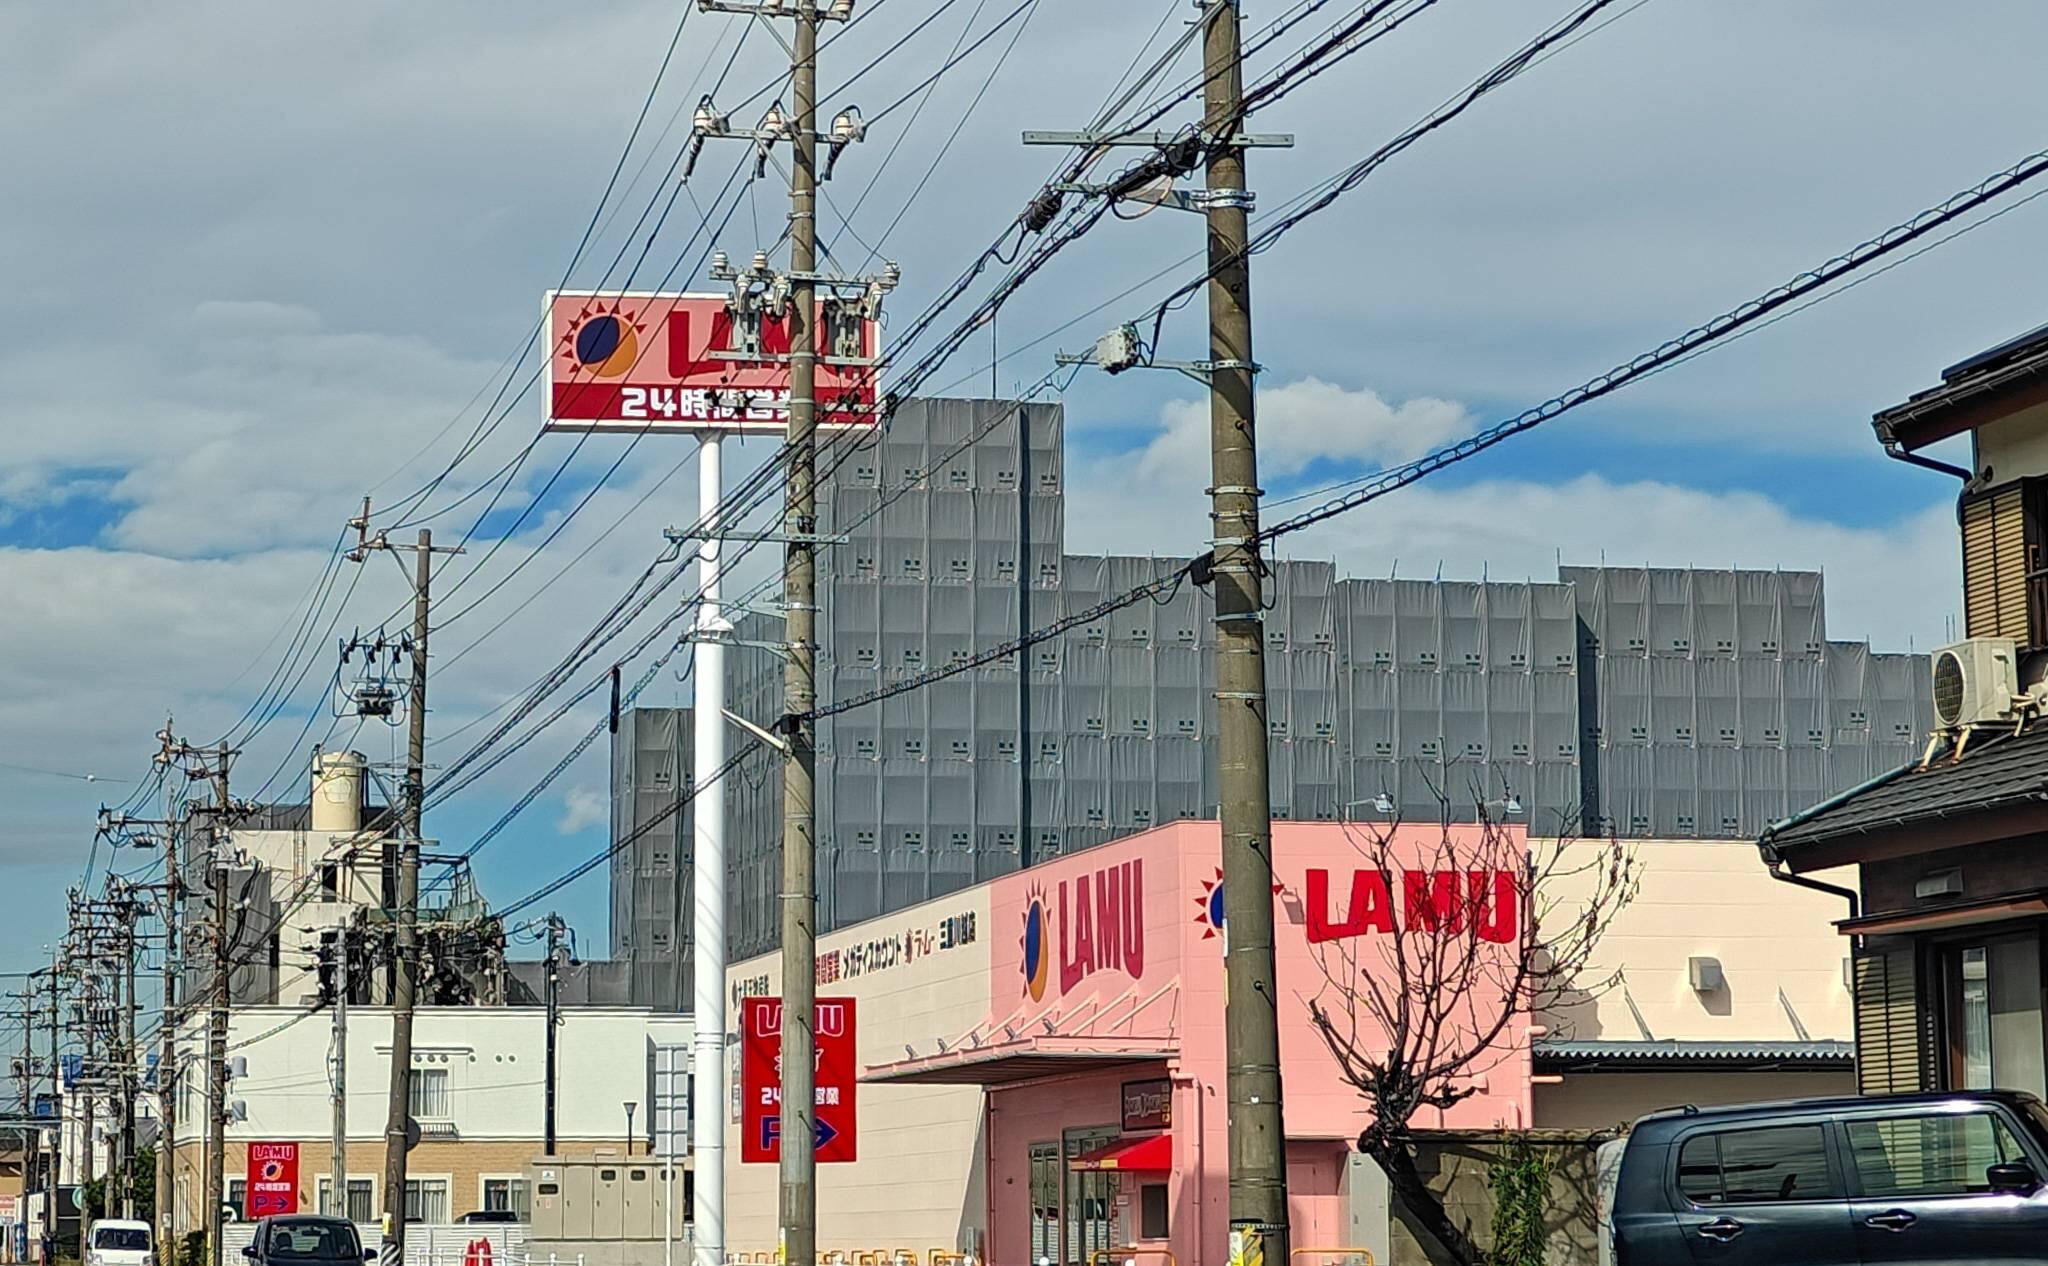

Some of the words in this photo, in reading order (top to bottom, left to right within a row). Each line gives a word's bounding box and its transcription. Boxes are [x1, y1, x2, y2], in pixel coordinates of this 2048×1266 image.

[1059, 858, 1144, 997] LAMU
[1306, 869, 1517, 944] LAMU
[757, 1004, 844, 1037] LU
[253, 1145, 294, 1160] LAMU
